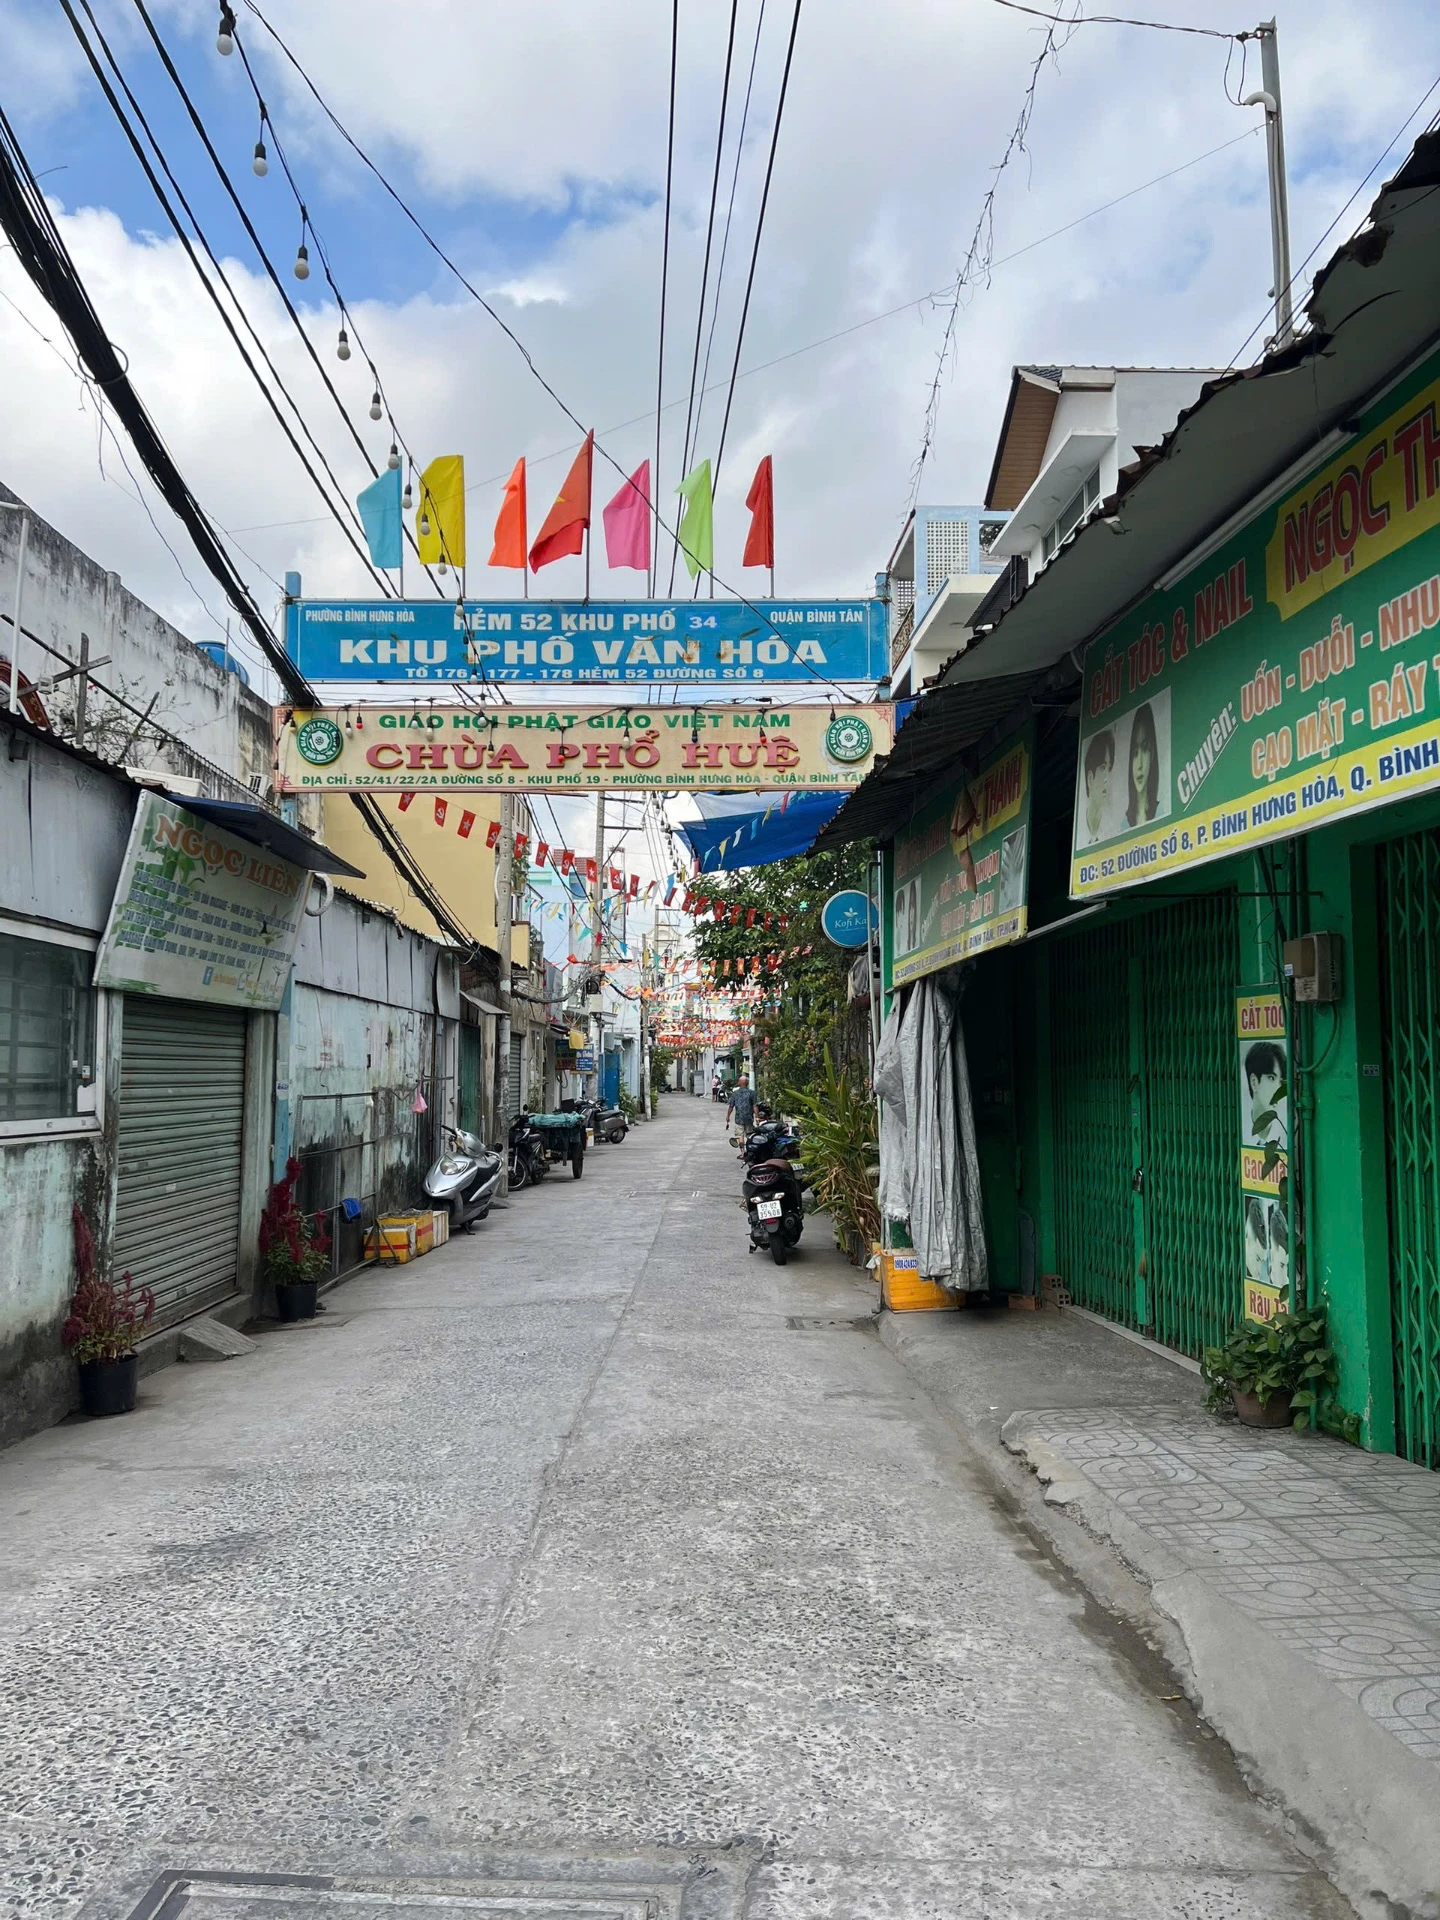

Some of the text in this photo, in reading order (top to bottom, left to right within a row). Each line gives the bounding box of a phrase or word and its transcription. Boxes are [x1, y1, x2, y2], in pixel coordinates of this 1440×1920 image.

[1284, 441, 1389, 594] NGỌC
[305, 607, 415, 623] PHƯỜNG BÌNH HƯNG HÒA
[453, 607, 718, 631] HẺM 52 KHU PHỐ 34
[770, 609, 863, 625] QUẬN BÌNH TÂN
[340, 632, 828, 665] KHU PHỐ VĂN HÓA
[1089, 558, 1254, 718] CẮT TÓC & NAIL
[405, 665, 428, 678] TỔ
[434, 668, 468, 679] 176
[487, 668, 520, 679] 177
[540, 668, 573, 679] 178
[578, 666, 619, 679] HẺM
[625, 669, 647, 679] 52
[653, 667, 717, 679] ĐƯỜNG
[723, 665, 746, 679] SỐ
[753, 669, 764, 678] 8
[1241, 660, 1282, 723] UỐN
[1300, 615, 1355, 695] DUỖI
[379, 711, 444, 728] GIÁO
[507, 713, 578, 733] PHẬT
[587, 712, 651, 728] GIÁO
[663, 713, 724, 732] VIỆT
[732, 714, 791, 728] NAM
[1250, 725, 1292, 782] CẠO
[1297, 697, 1347, 759] MẶT
[1369, 661, 1428, 731] RÁY
[365, 734, 530, 769] CHÙA
[546, 724, 661, 769] PHỔ
[682, 735, 800, 773] HUỆ
[1175, 701, 1240, 806] Chuyên:
[302, 775, 322, 787] ĐỊA
[355, 775, 437, 785] 52/41/22/2A
[441, 773, 484, 785] ĐƯỜNG
[486, 772, 504, 784] SỐ
[507, 775, 515, 784] 8
[527, 775, 552, 785] KHU
[556, 772, 582, 785] PHỐ
[586, 775, 600, 784] 19
[613, 773, 662, 785] PHƯỜNG
[666, 773, 695, 784] BÌNH
[699, 774, 732, 784] HƯNG
[736, 773, 761, 784] HÒA
[773, 773, 806, 787] QUẬN
[810, 772, 839, 784] BÌNH
[843, 771, 866, 783] TÂN
[1080, 737, 1440, 885] ĐC: 52 ĐƯỜNG SỐ 8, P. BÌNH HƯNG HÒA, Q. BÌNH
[154, 814, 247, 876] NGỌC
[1241, 999, 1261, 1030] CẮT
[1249, 1289, 1270, 1321] Ráy
